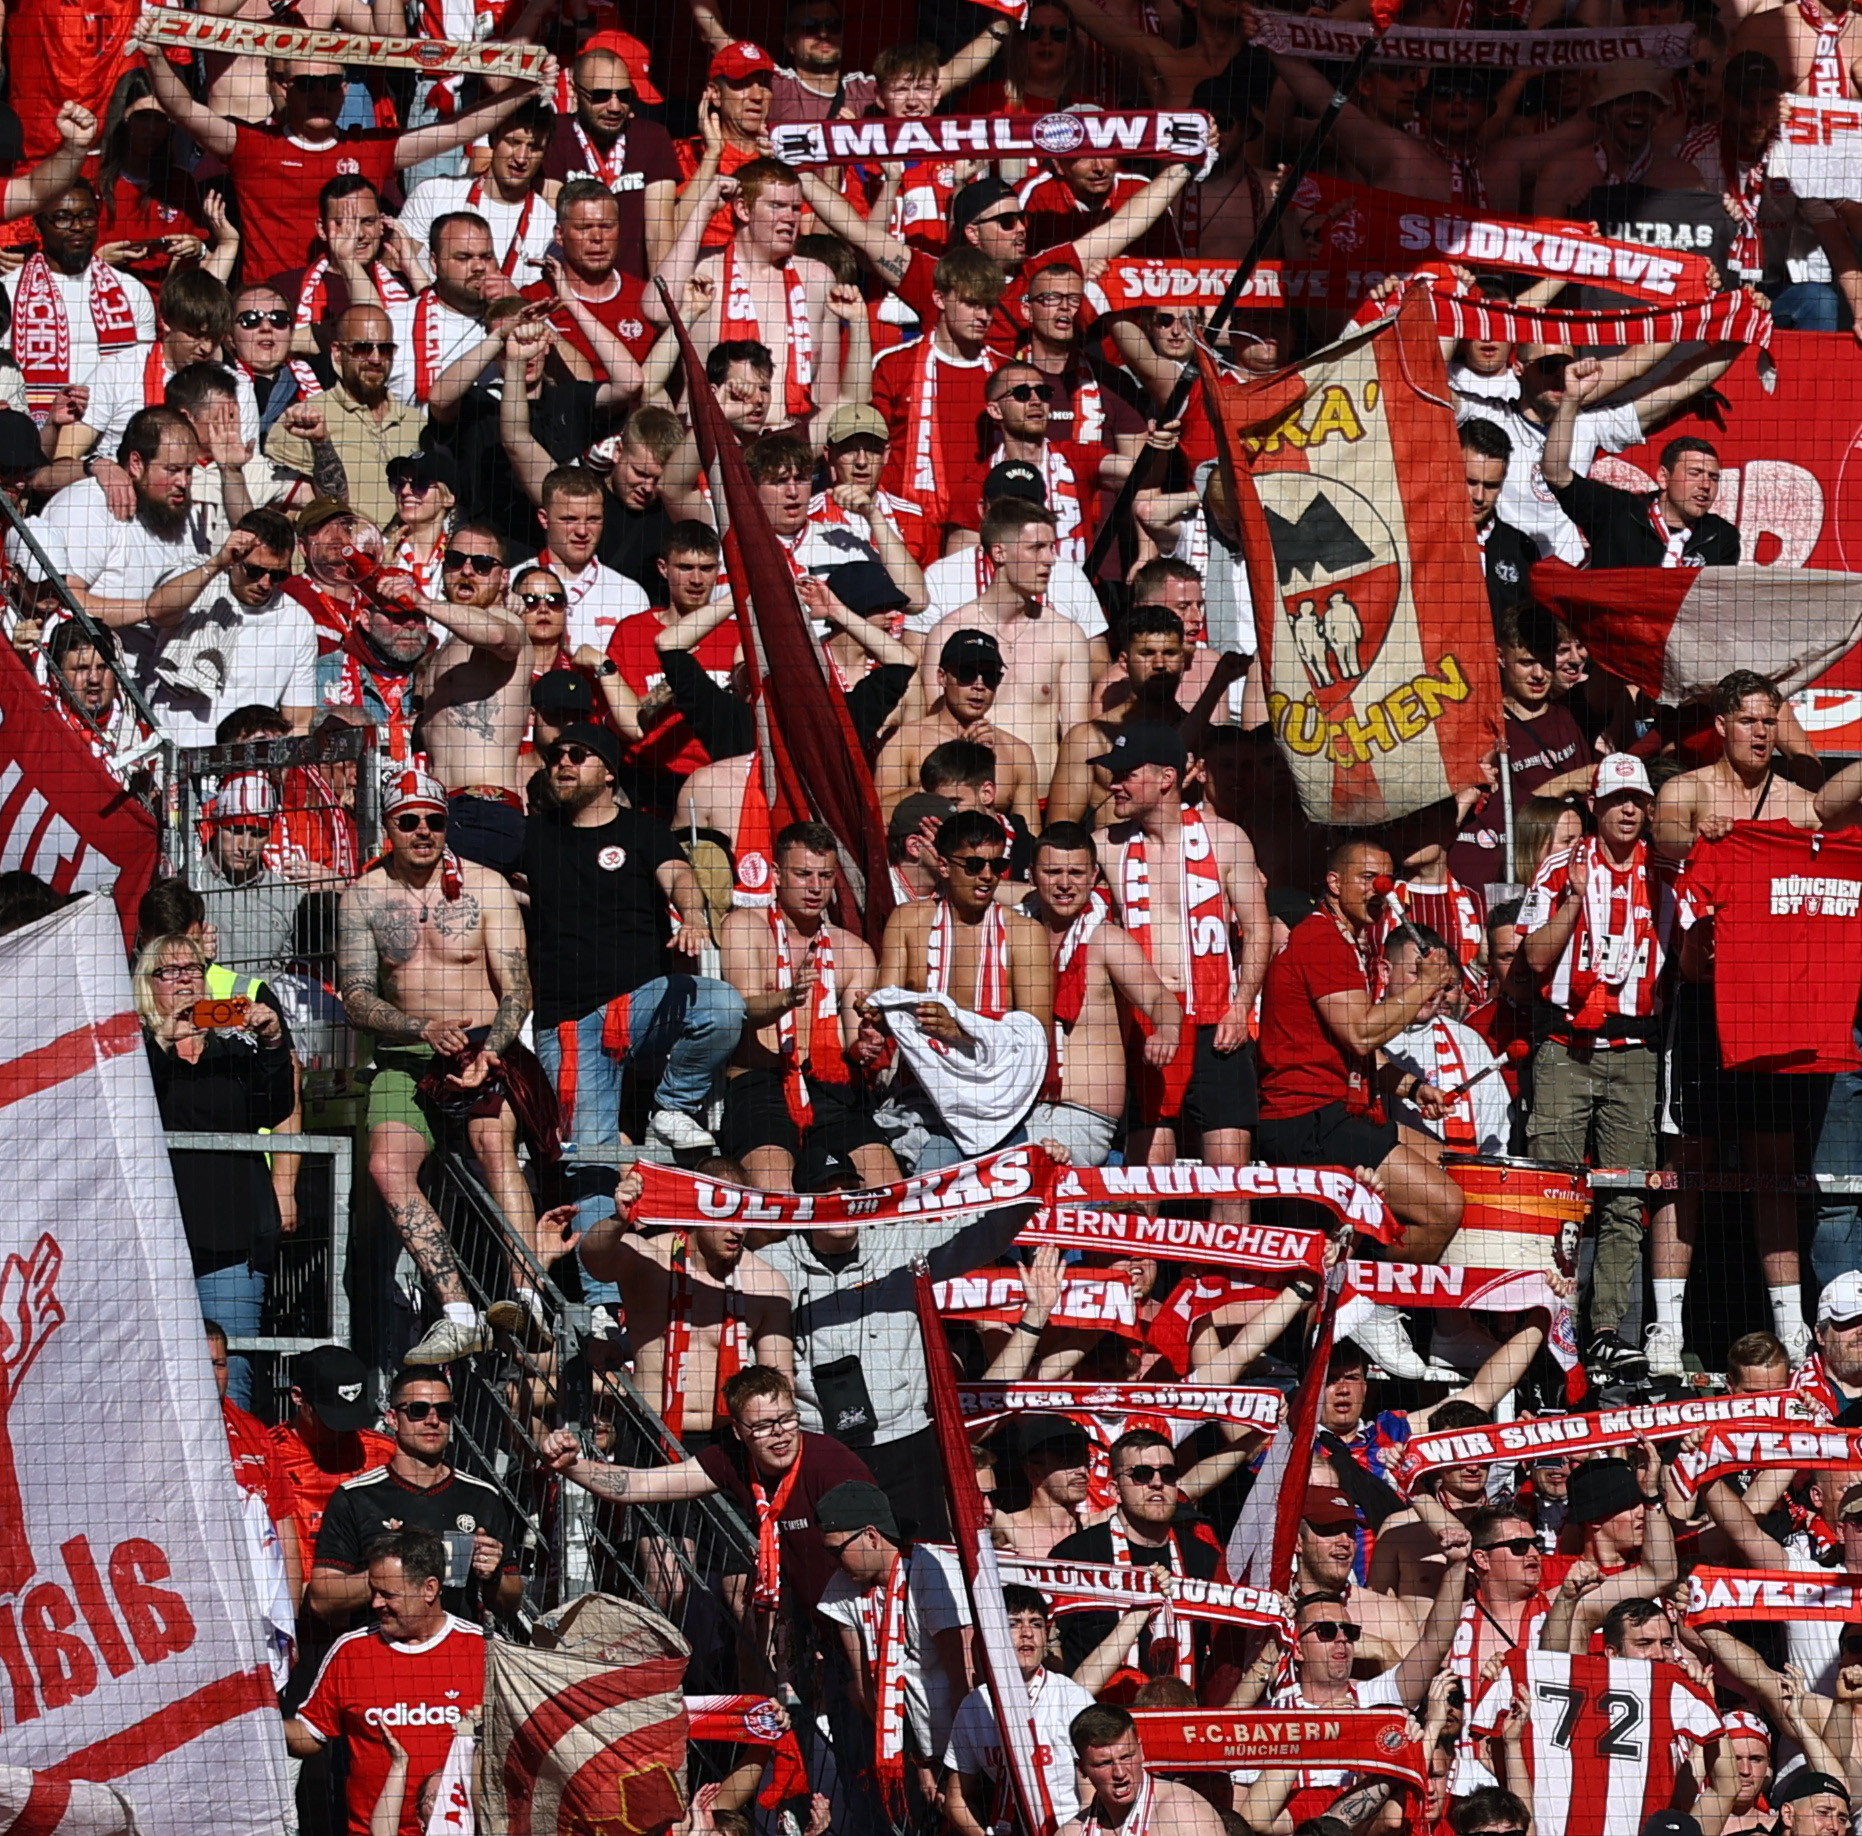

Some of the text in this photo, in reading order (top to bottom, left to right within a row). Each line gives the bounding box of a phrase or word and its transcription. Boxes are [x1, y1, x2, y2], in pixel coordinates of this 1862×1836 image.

[1399, 211, 1685, 295] SÜDKURVE
[1769, 874, 1862, 897] MÜNCHEN
[1770, 897, 1859, 917] IST ROT
[1144, 1216, 1312, 1260] MÜNCHEN
[1130, 1386, 1282, 1424] SÜDKUR
[1417, 1398, 1779, 1463] WIR SIND MÜNCHEN
[364, 1703, 462, 1728] adidas
[1534, 1679, 1645, 1763] 72
[1182, 1720, 1342, 1744] F.C.BAYERN
[1223, 1743, 1301, 1758] MÜNCHEN
